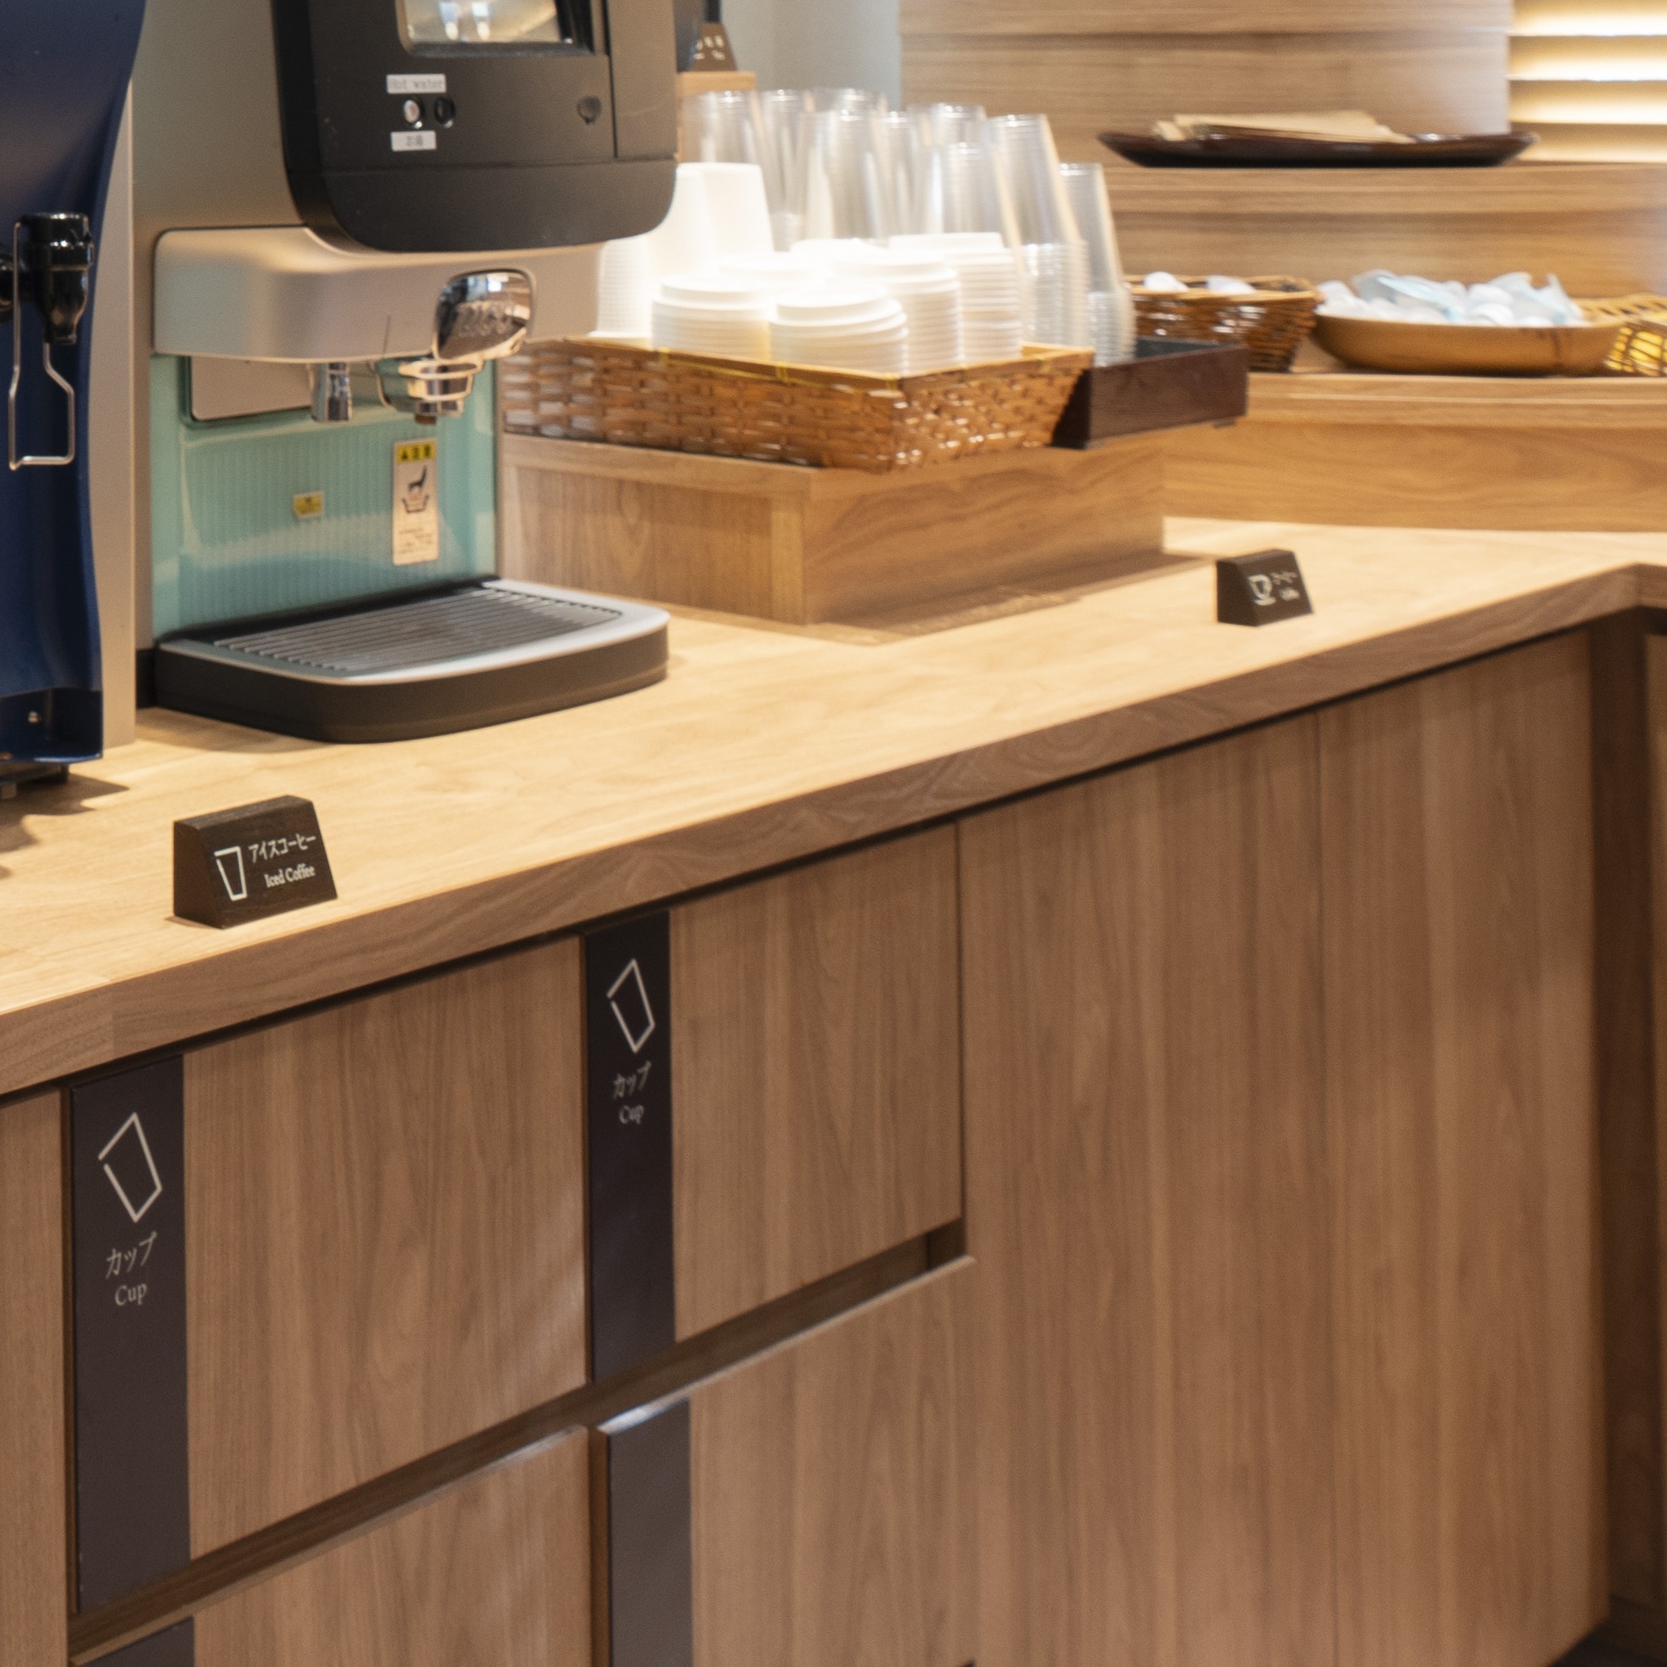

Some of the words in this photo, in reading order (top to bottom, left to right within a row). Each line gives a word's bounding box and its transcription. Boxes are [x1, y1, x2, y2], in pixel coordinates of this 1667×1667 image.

[248, 833, 316, 864] アイスコーヒー
[264, 868, 283, 888] Iced
[285, 862, 316, 883] Coffee
[105, 1231, 157, 1279] カップ
[114, 1283, 147, 1306] Cup
